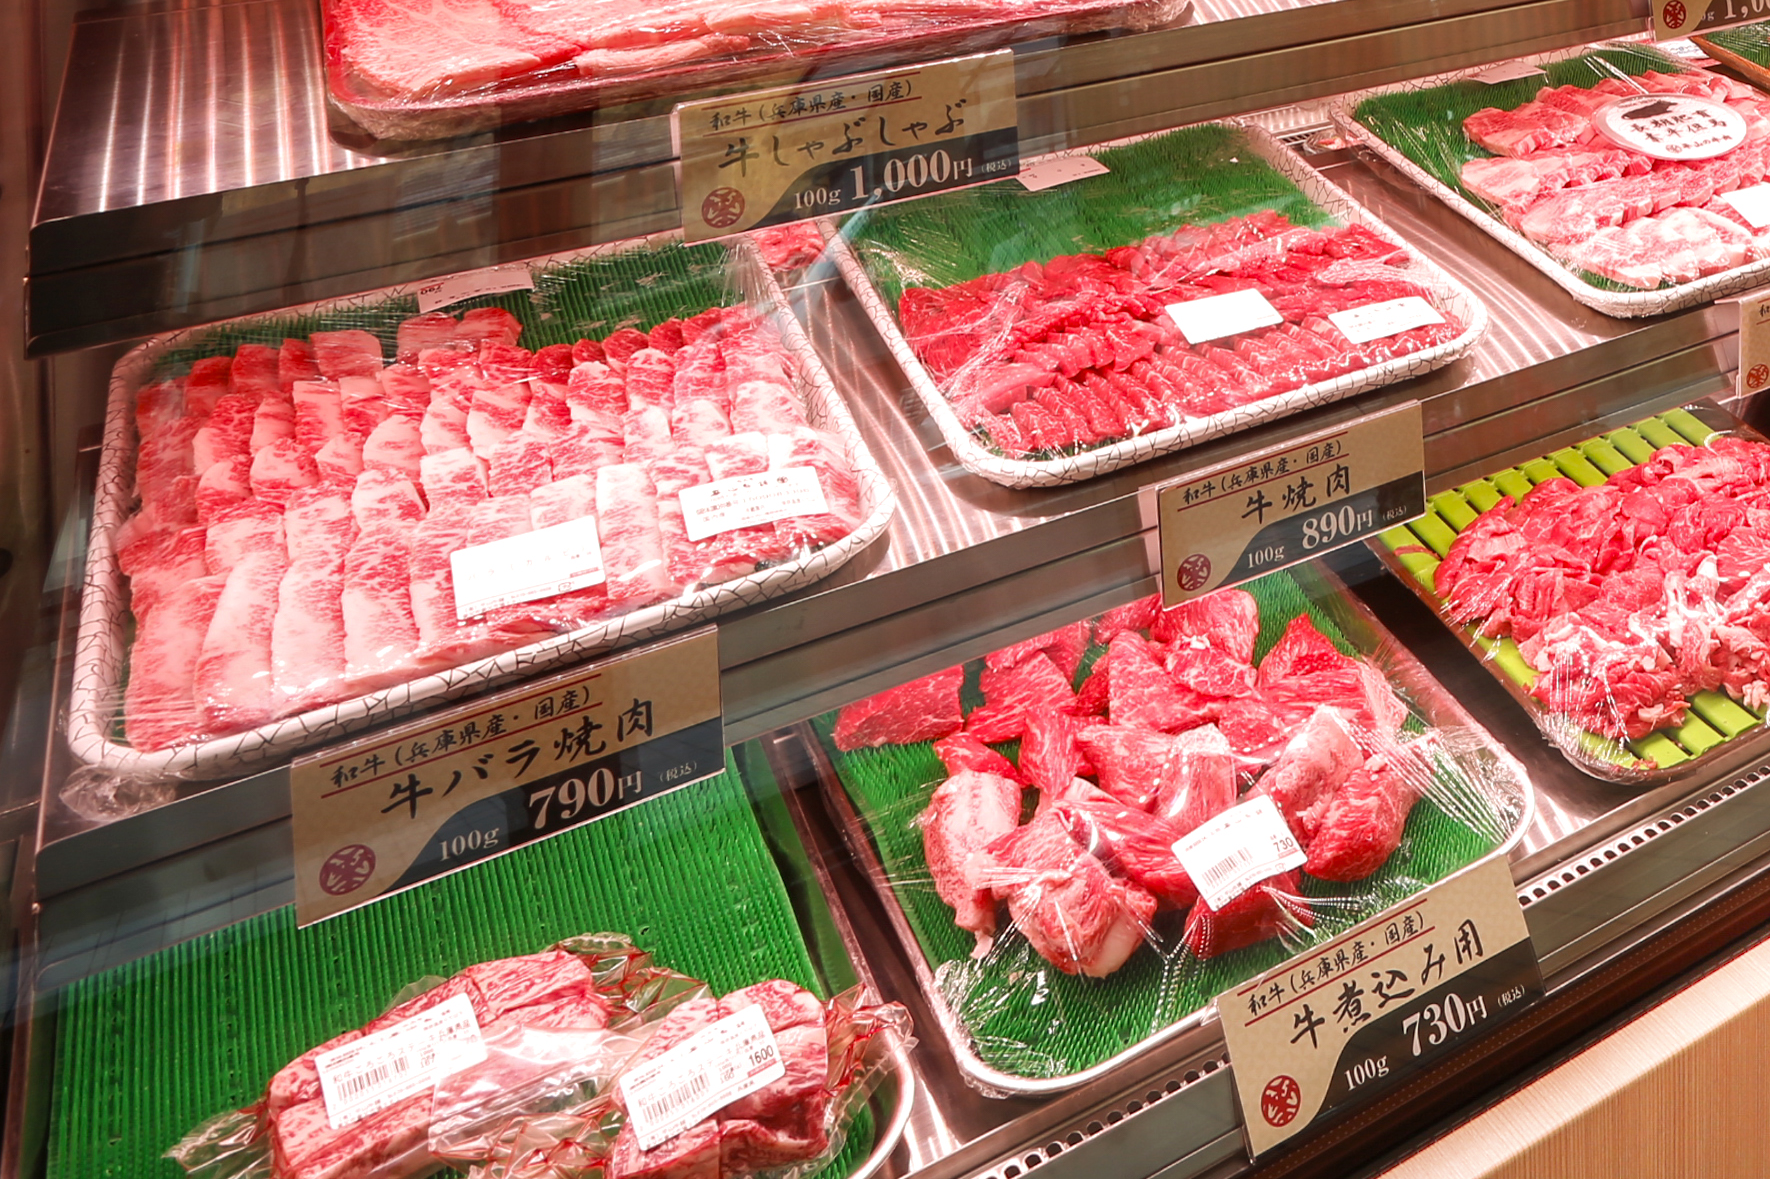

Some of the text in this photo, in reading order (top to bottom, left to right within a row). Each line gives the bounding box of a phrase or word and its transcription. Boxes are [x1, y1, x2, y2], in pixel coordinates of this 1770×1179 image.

[708, 79, 913, 132] 和牛(兵庫県産・国産)
[718, 98, 967, 178] 牛しゃぶしゃぶ
[794, 188, 841, 210] 100g
[1182, 439, 1342, 506] 和牛(兵庫県産・国産)
[1241, 463, 1351, 525] 牛焼肉
[1248, 545, 1285, 568] 100g
[1302, 505, 1373, 550] 890円
[330, 685, 591, 788] 和牛(兵庫県産・国産)
[381, 697, 655, 819] 牛バラ焼肉
[439, 759, 698, 862] 100g 790円 (税込)
[1273, 836, 1295, 853] 730
[1246, 911, 1424, 1016] 和牛(兵庫県産・国産)
[1290, 919, 1485, 1049] 牛煮込み用
[748, 1044, 774, 1067] 1600
[1344, 1054, 1390, 1091] 100g
[1401, 992, 1488, 1057] 730円
